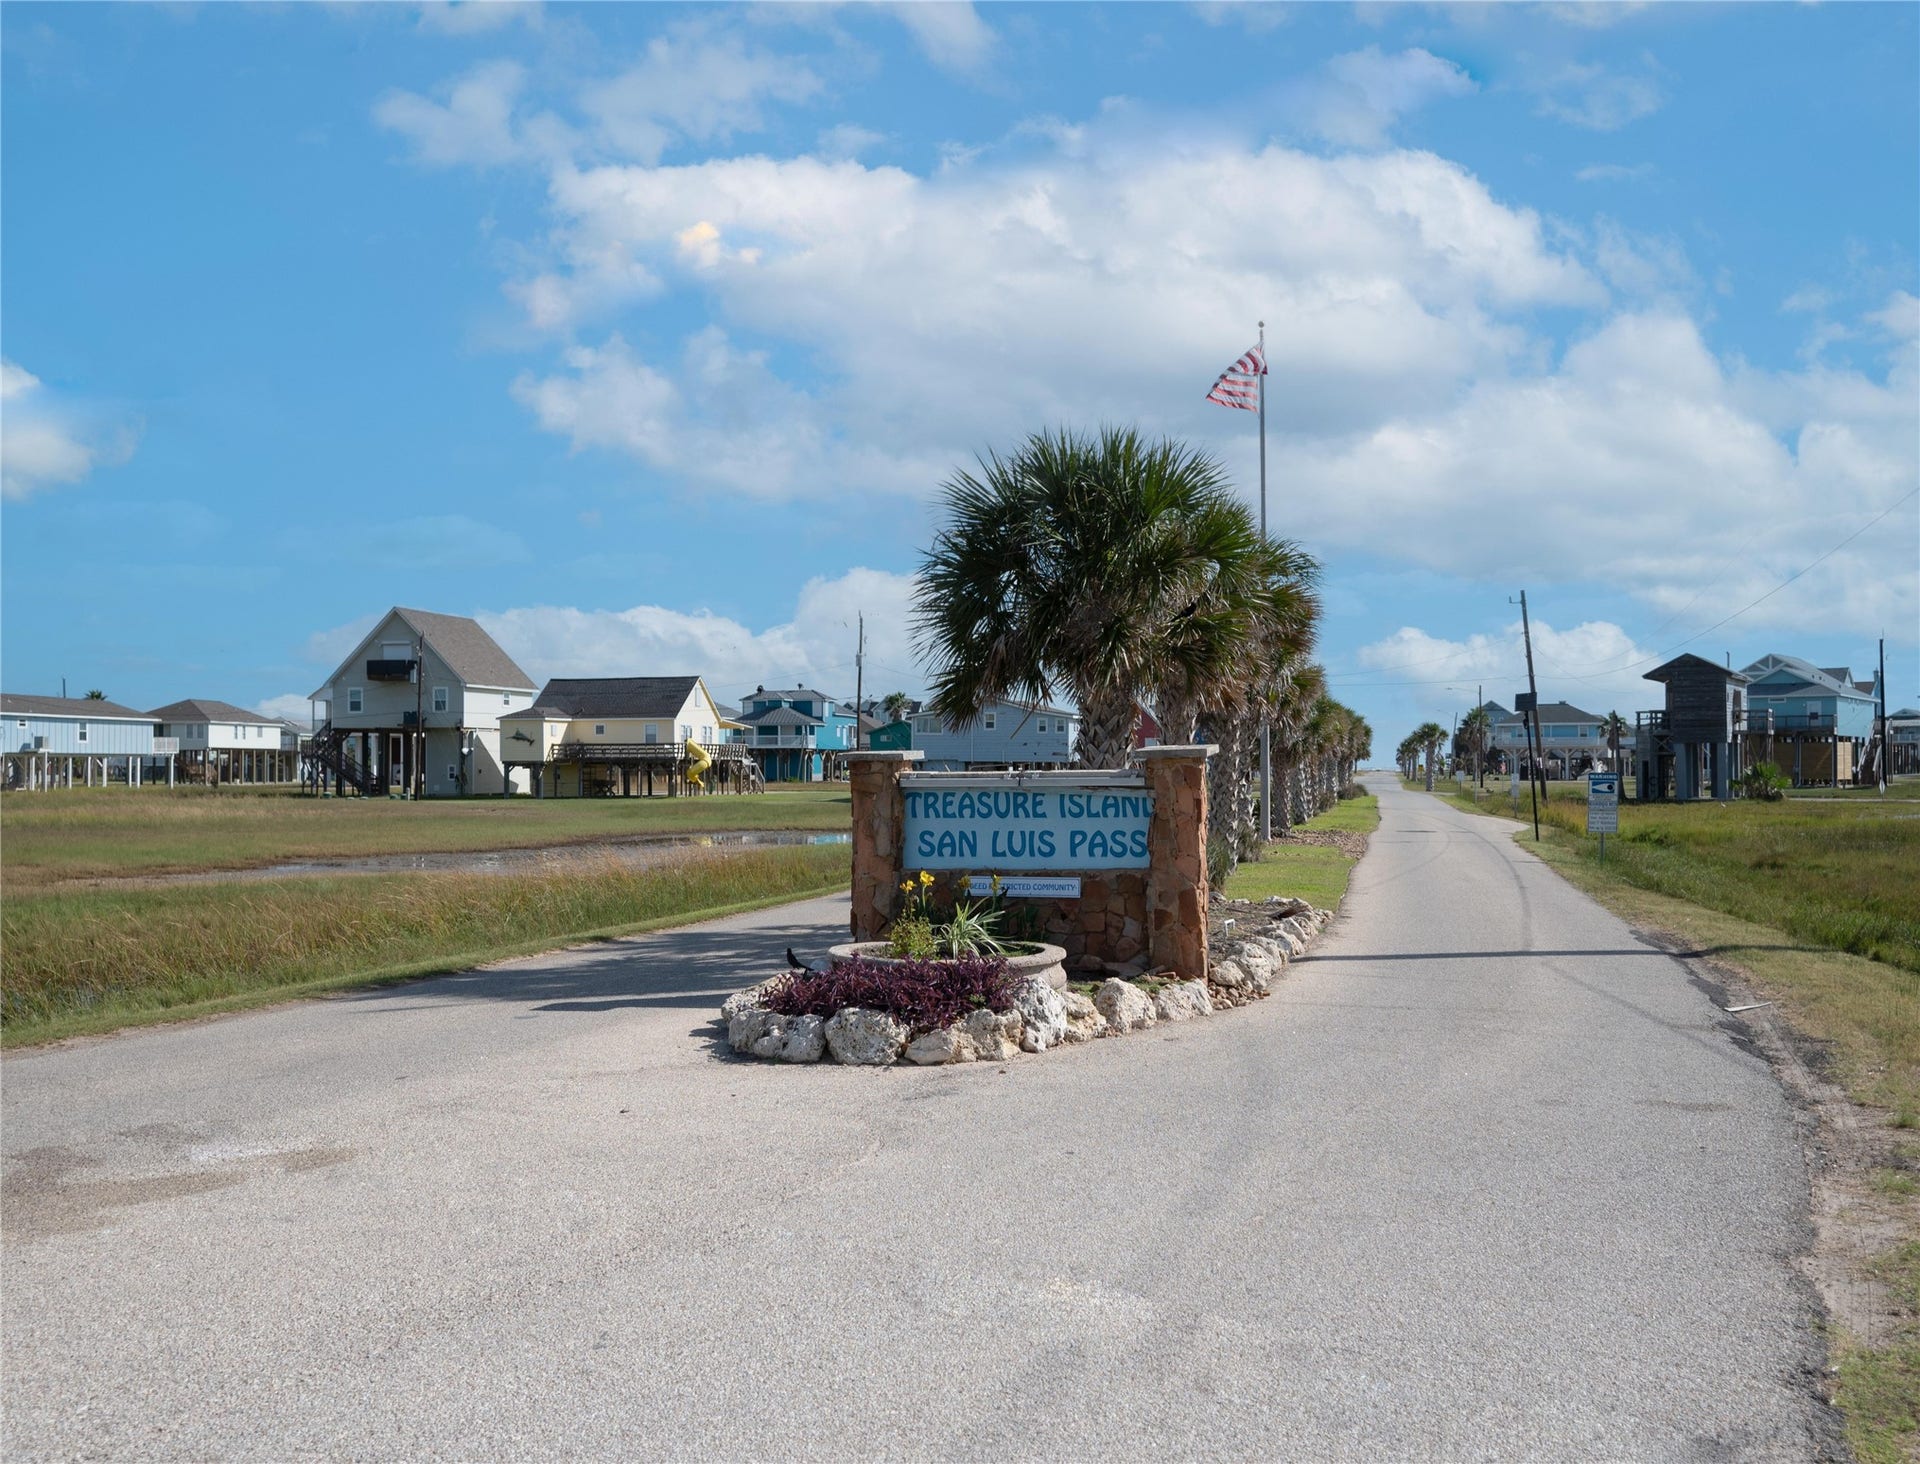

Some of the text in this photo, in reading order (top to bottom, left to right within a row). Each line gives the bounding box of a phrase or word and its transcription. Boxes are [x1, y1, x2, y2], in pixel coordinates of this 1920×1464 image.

[905, 791, 1047, 819] TREASURE
[918, 830, 1147, 858] SAN LUIS PASS
[1032, 883, 1075, 891] COMMUNITY
